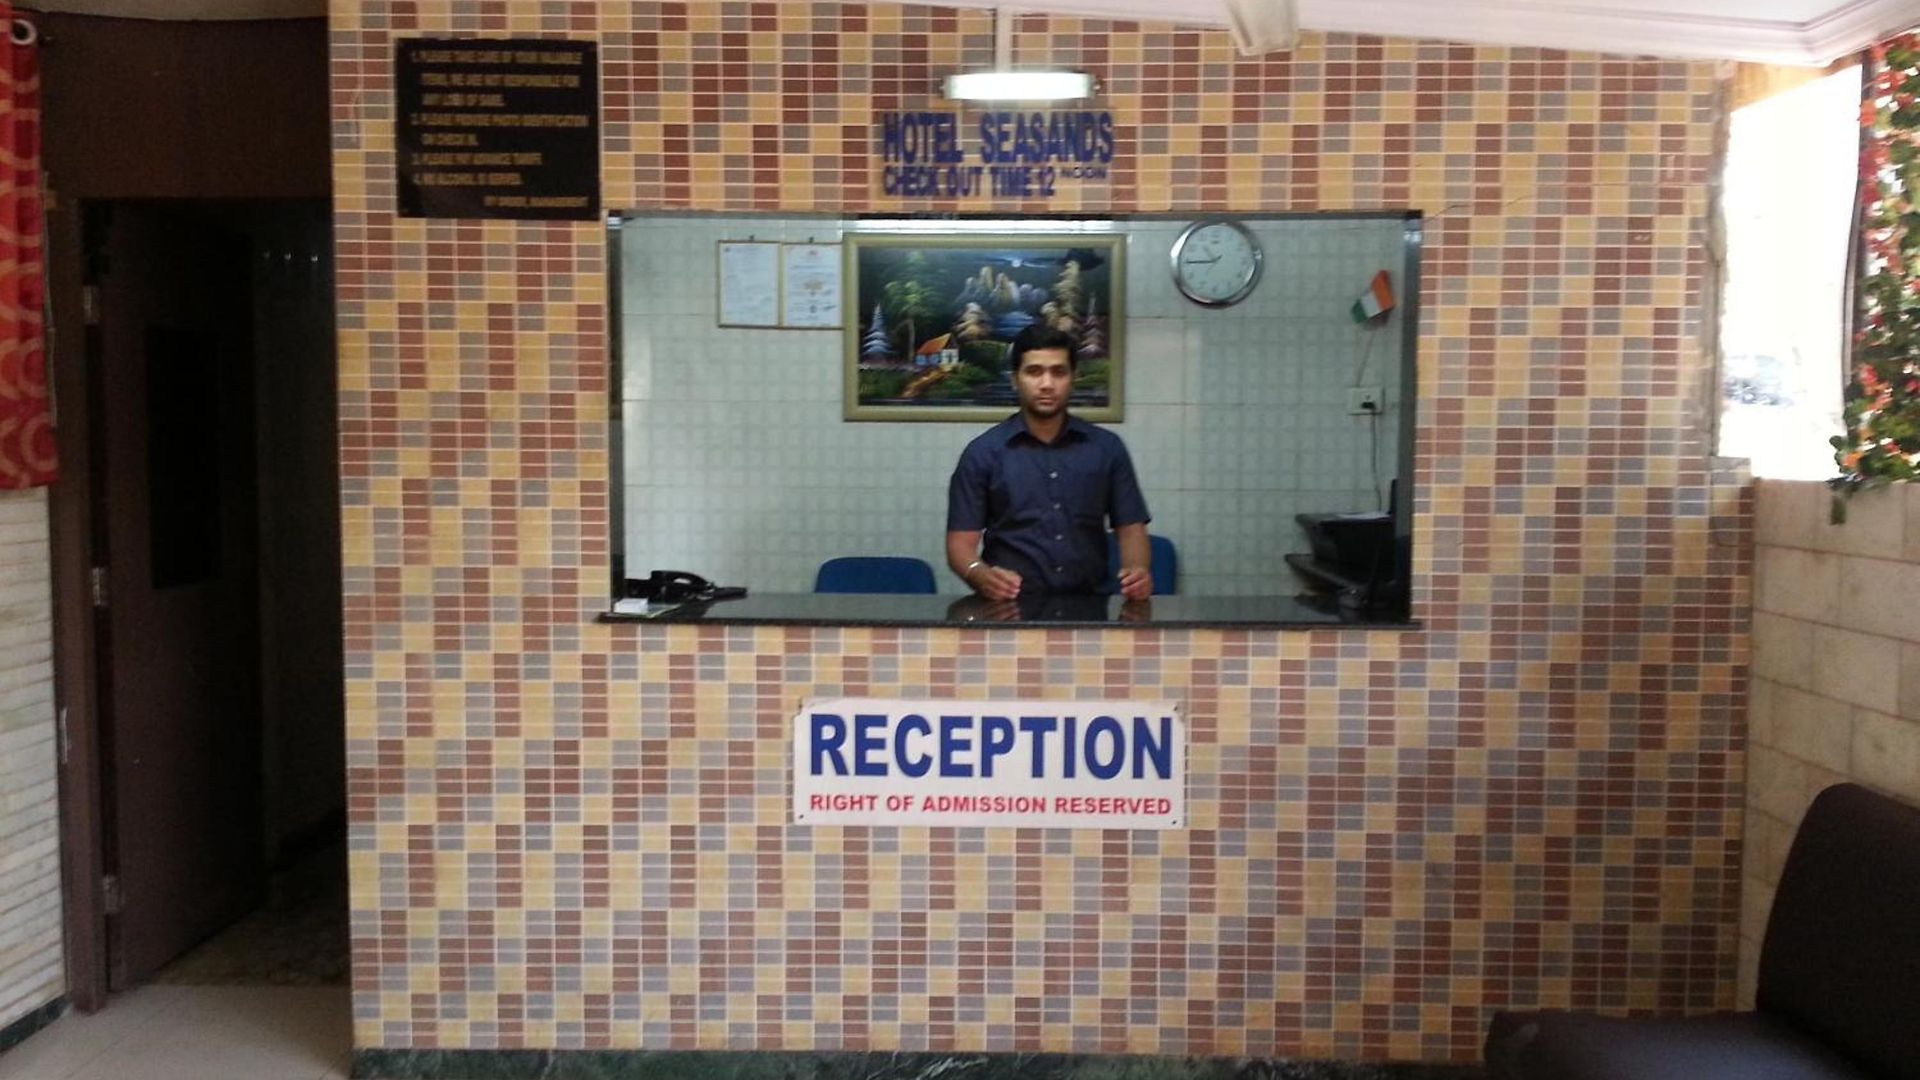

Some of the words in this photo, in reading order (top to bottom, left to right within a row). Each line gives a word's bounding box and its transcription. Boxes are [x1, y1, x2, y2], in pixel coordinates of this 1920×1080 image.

[883, 112, 963, 164] HOTEL
[981, 111, 1113, 164] SEASANDS
[883, 166, 939, 197] CHECK
[947, 166, 982, 197] OUT
[990, 166, 1032, 197] TIME
[1038, 166, 1055, 197] 12
[1060, 167, 1107, 179] NOON
[810, 713, 1172, 780] RECEPTION
[810, 795, 878, 812] RIGHT
[887, 795, 914, 813] OF
[922, 796, 1046, 814] ADMISSION
[1055, 797, 1171, 815] RESERVED
